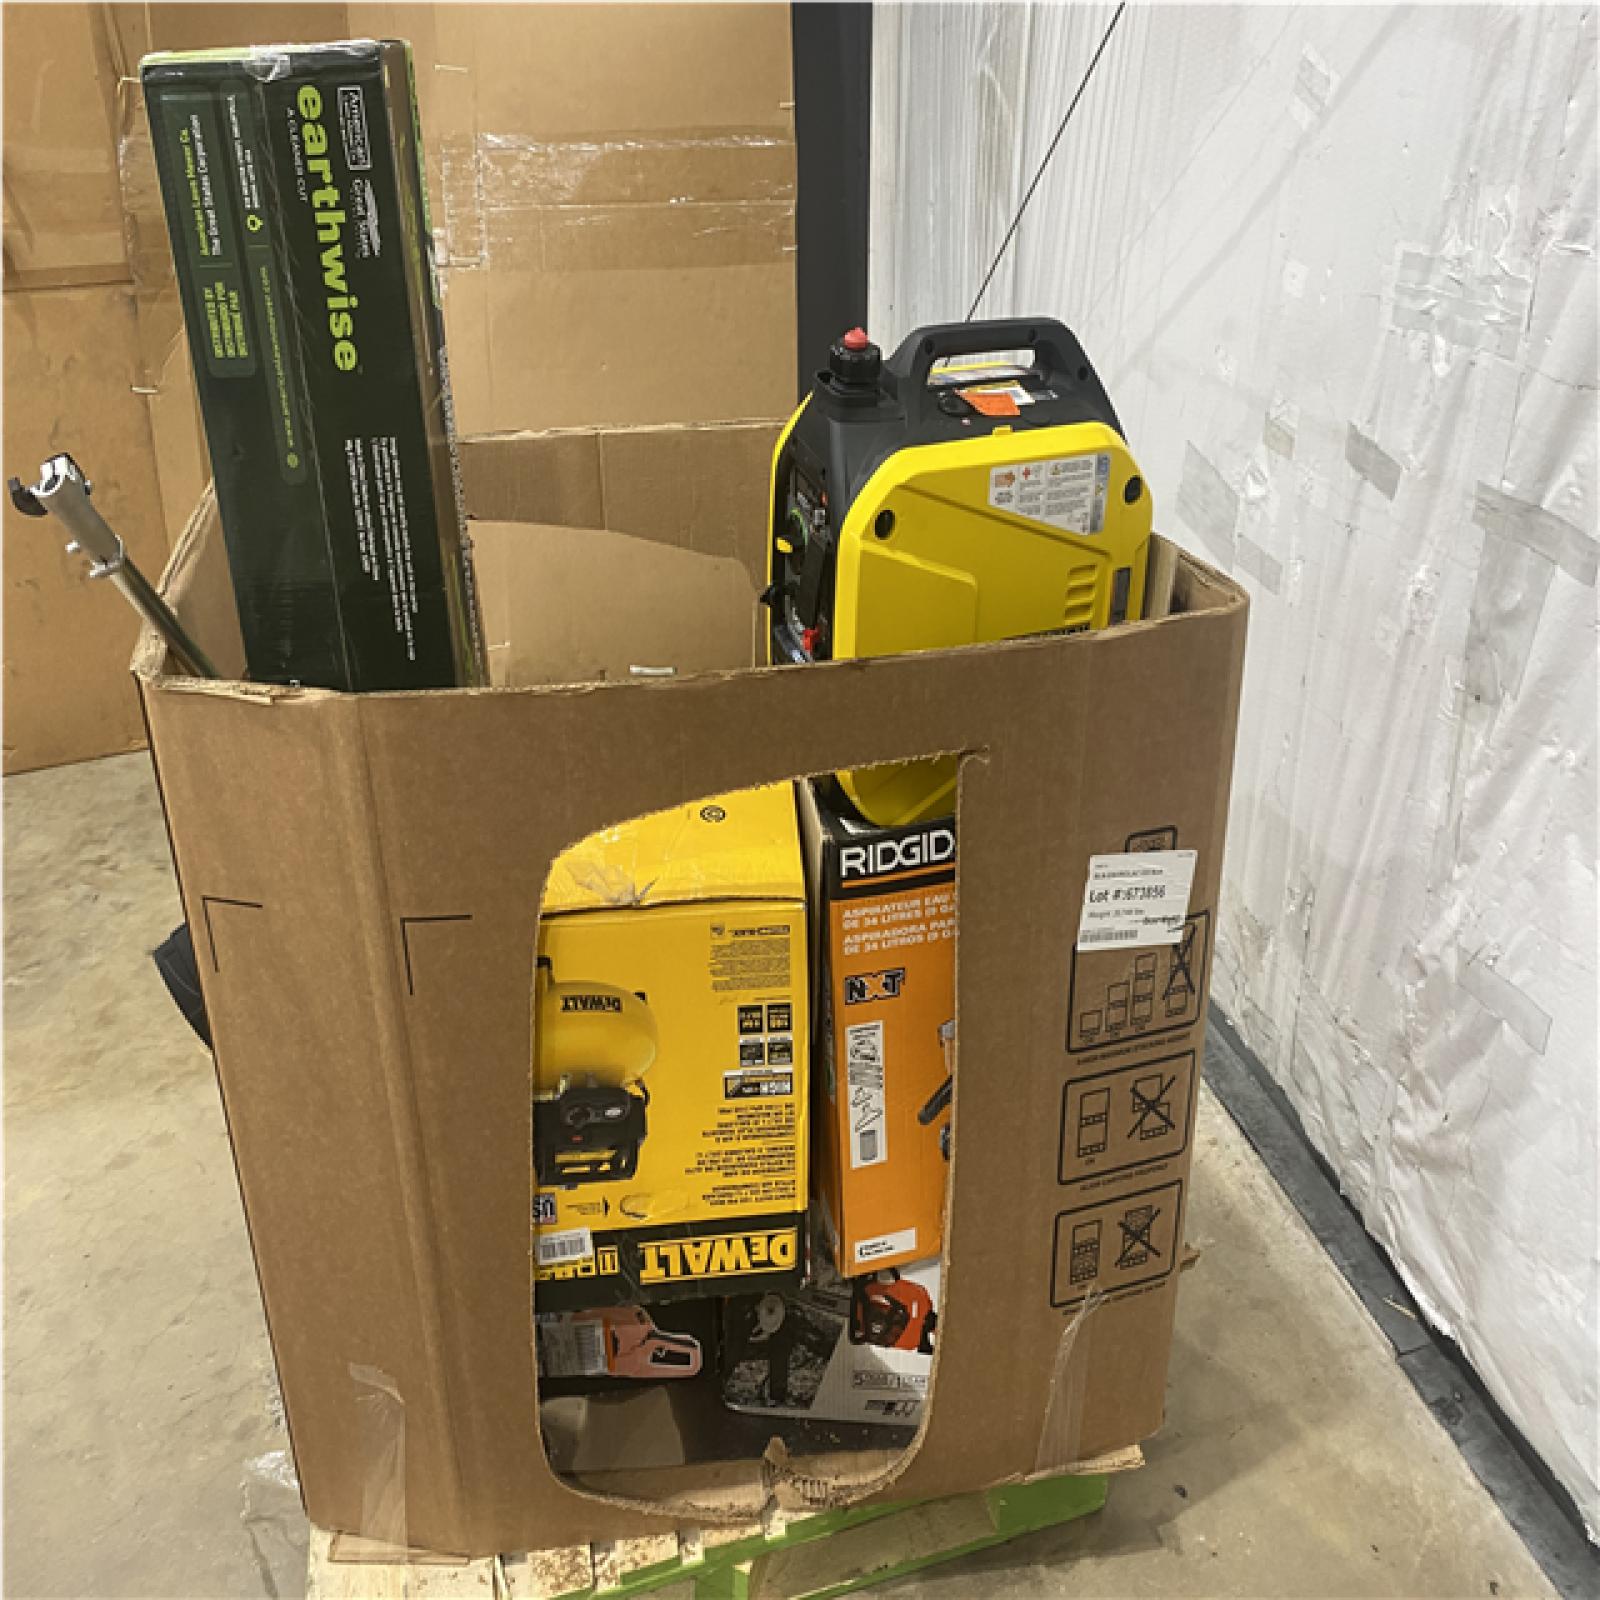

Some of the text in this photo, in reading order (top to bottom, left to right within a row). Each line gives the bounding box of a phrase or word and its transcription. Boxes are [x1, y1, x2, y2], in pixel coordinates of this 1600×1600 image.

[297, 85, 358, 370] earthwise
[840, 829, 956, 878] RIDGID
[1090, 889, 1109, 903] Lot
[844, 899, 921, 918] ASPIRATEUR
[843, 918, 860, 930] DE
[844, 923, 928, 944] ASPIRADORA
[844, 943, 860, 955] DE
[845, 968, 905, 1005] NXT
